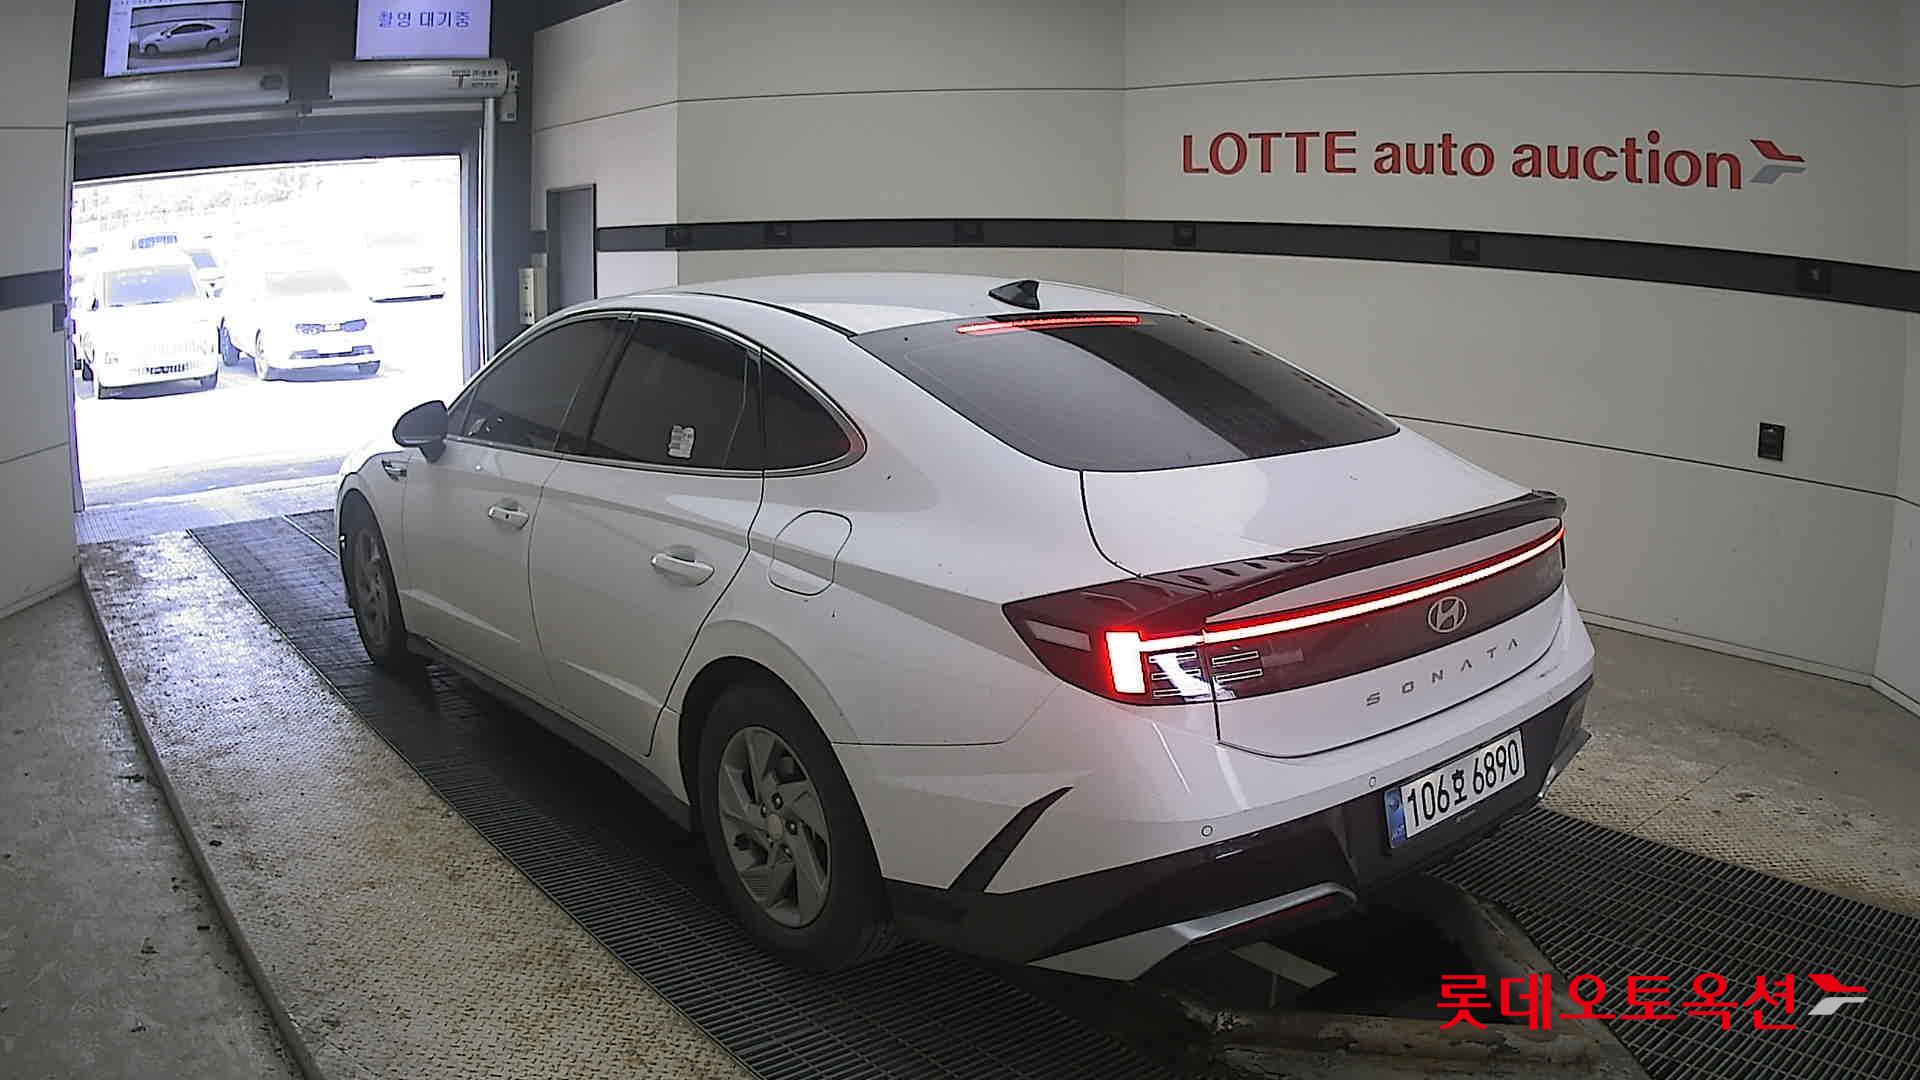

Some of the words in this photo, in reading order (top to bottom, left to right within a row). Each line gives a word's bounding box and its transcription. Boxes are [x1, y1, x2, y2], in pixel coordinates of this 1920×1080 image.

[419, 11, 472, 28] 대기중
[1182, 131, 1357, 174] LOTTE
[1373, 133, 1495, 177] auto
[1512, 130, 1743, 189] auction
[1365, 638, 1519, 706] SONATA
[1472, 739, 1520, 794] 6890
